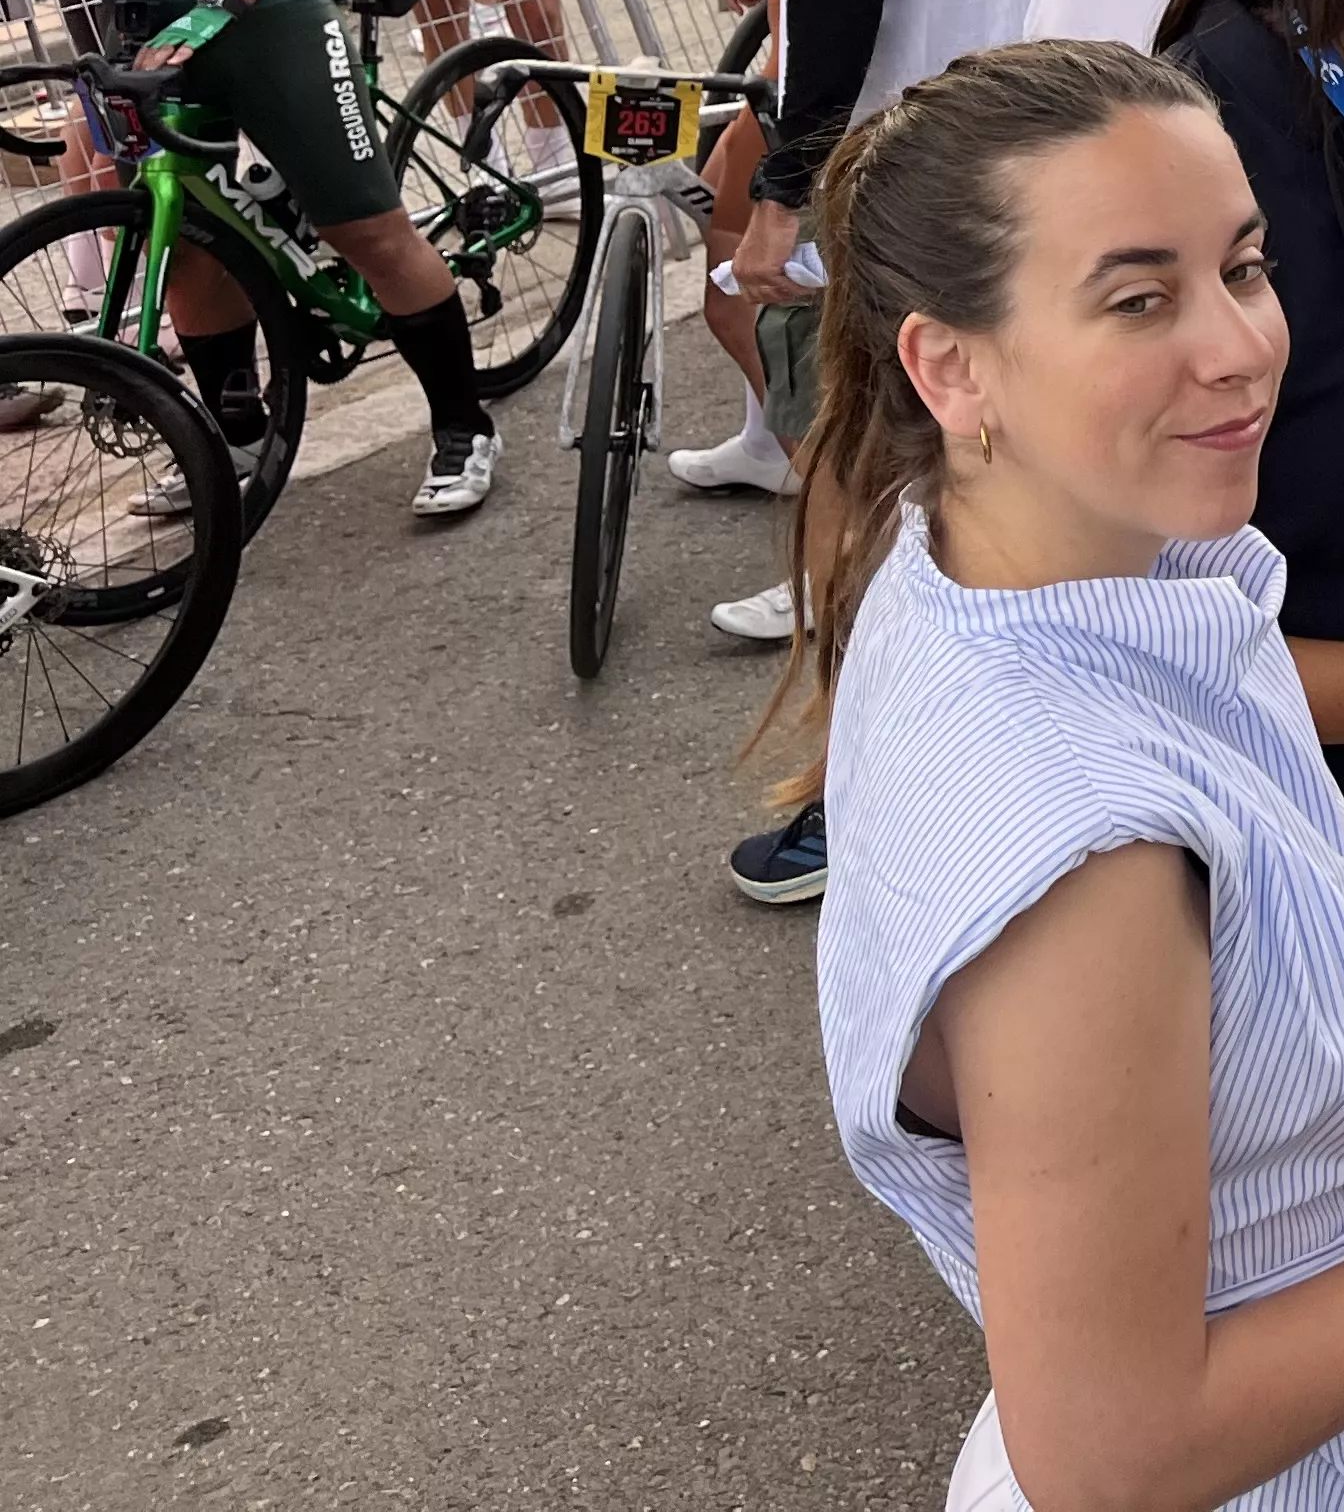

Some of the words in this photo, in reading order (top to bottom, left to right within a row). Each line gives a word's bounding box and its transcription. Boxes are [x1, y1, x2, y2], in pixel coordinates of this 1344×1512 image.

[323, 19, 351, 79] RGA
[334, 80, 375, 162] SEGUROS
[617, 110, 668, 137] 263
